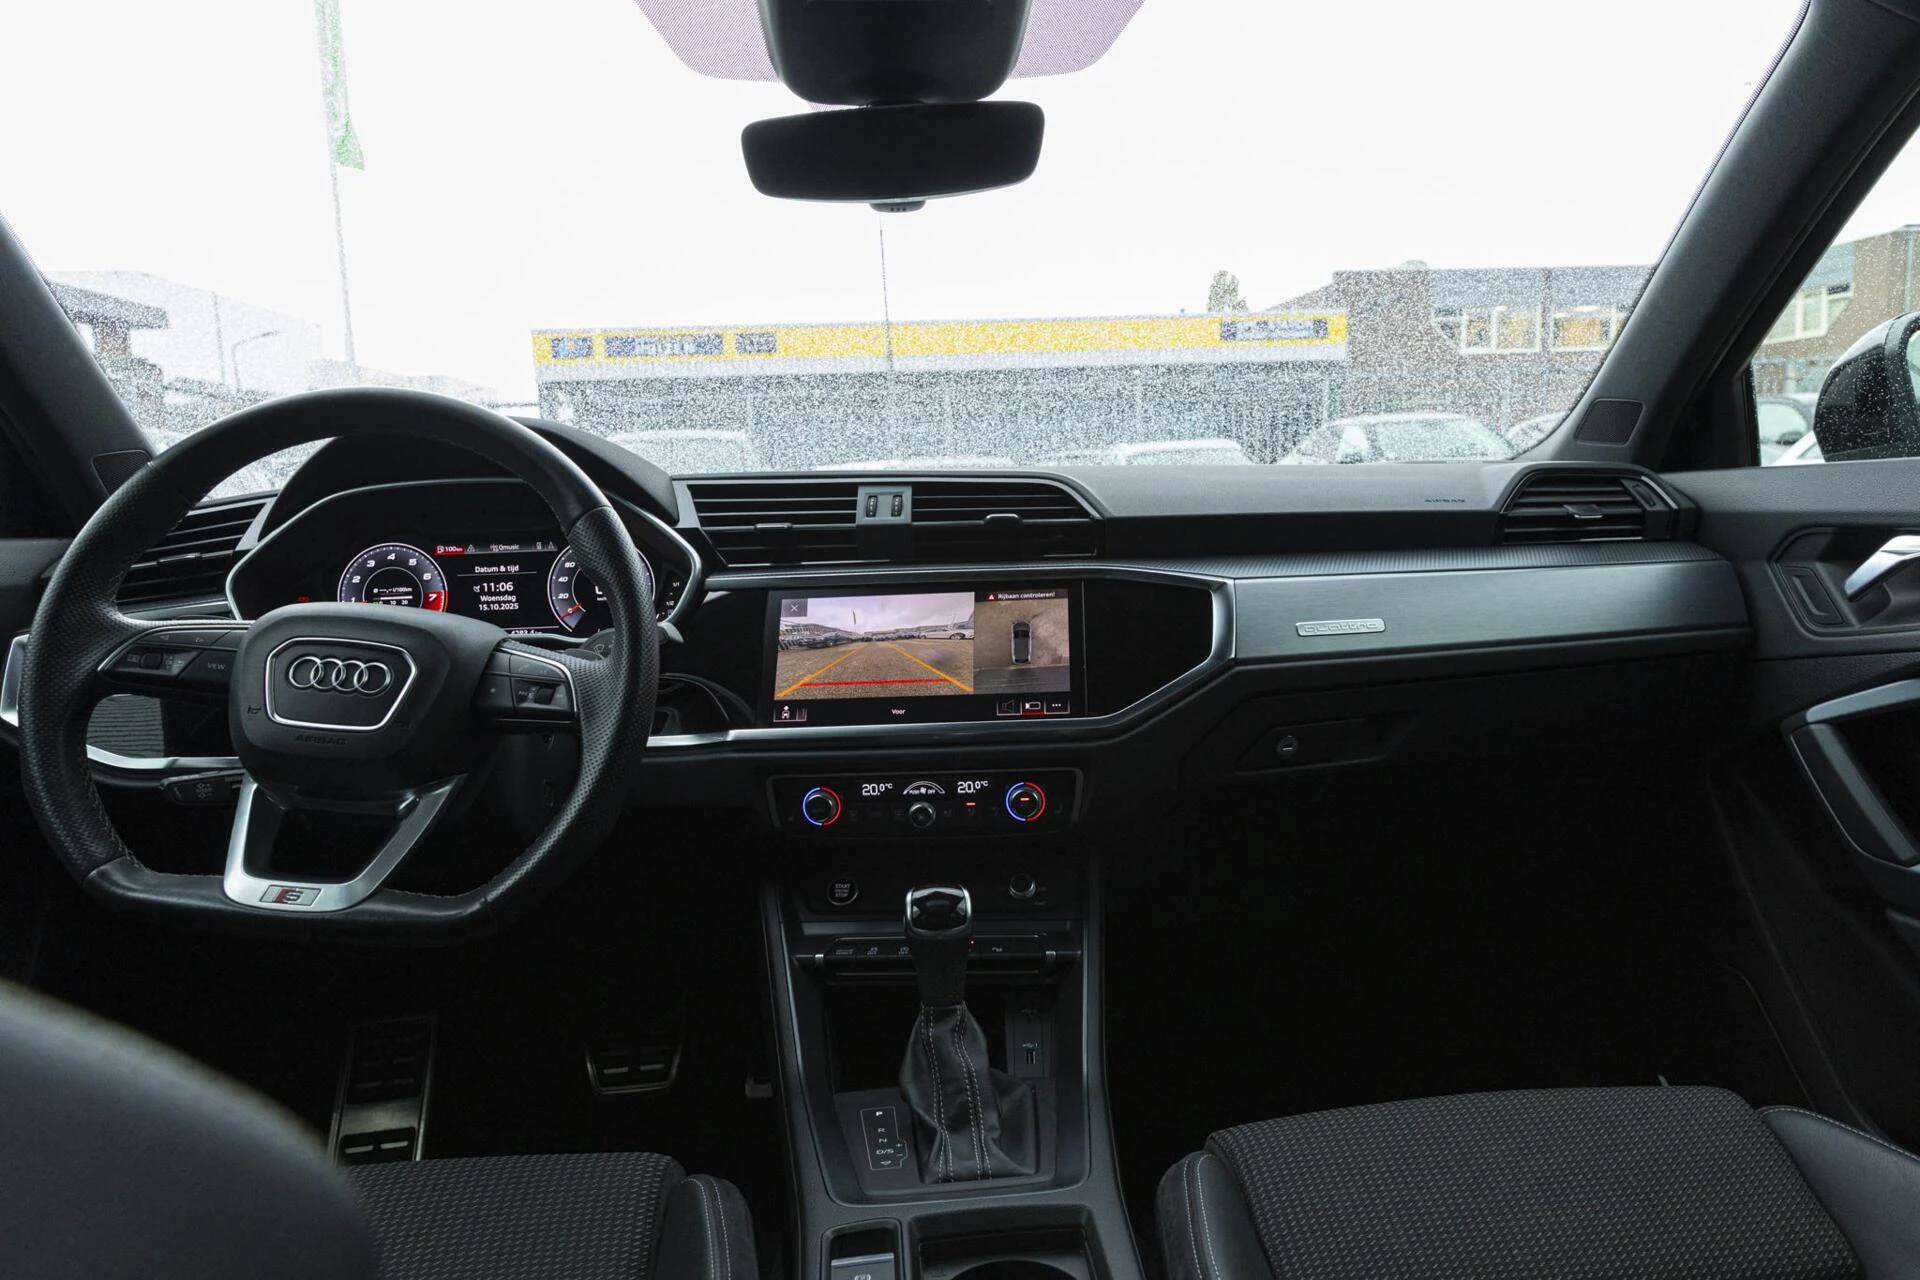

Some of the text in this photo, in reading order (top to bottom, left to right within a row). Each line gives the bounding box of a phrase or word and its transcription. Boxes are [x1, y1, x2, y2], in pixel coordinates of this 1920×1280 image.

[366, 559, 376, 568] 3
[408, 558, 417, 566] 5
[507, 564, 519, 573] tijd
[352, 575, 361, 583] 2
[423, 572, 432, 580] 6
[482, 582, 514, 592] 11:06
[428, 593, 437, 601] 7
[480, 594, 516, 602] Woensdag
[479, 602, 519, 611] 15.10.2025
[1304, 621, 1378, 633] quattro
[295, 734, 346, 745] AIRBAG
